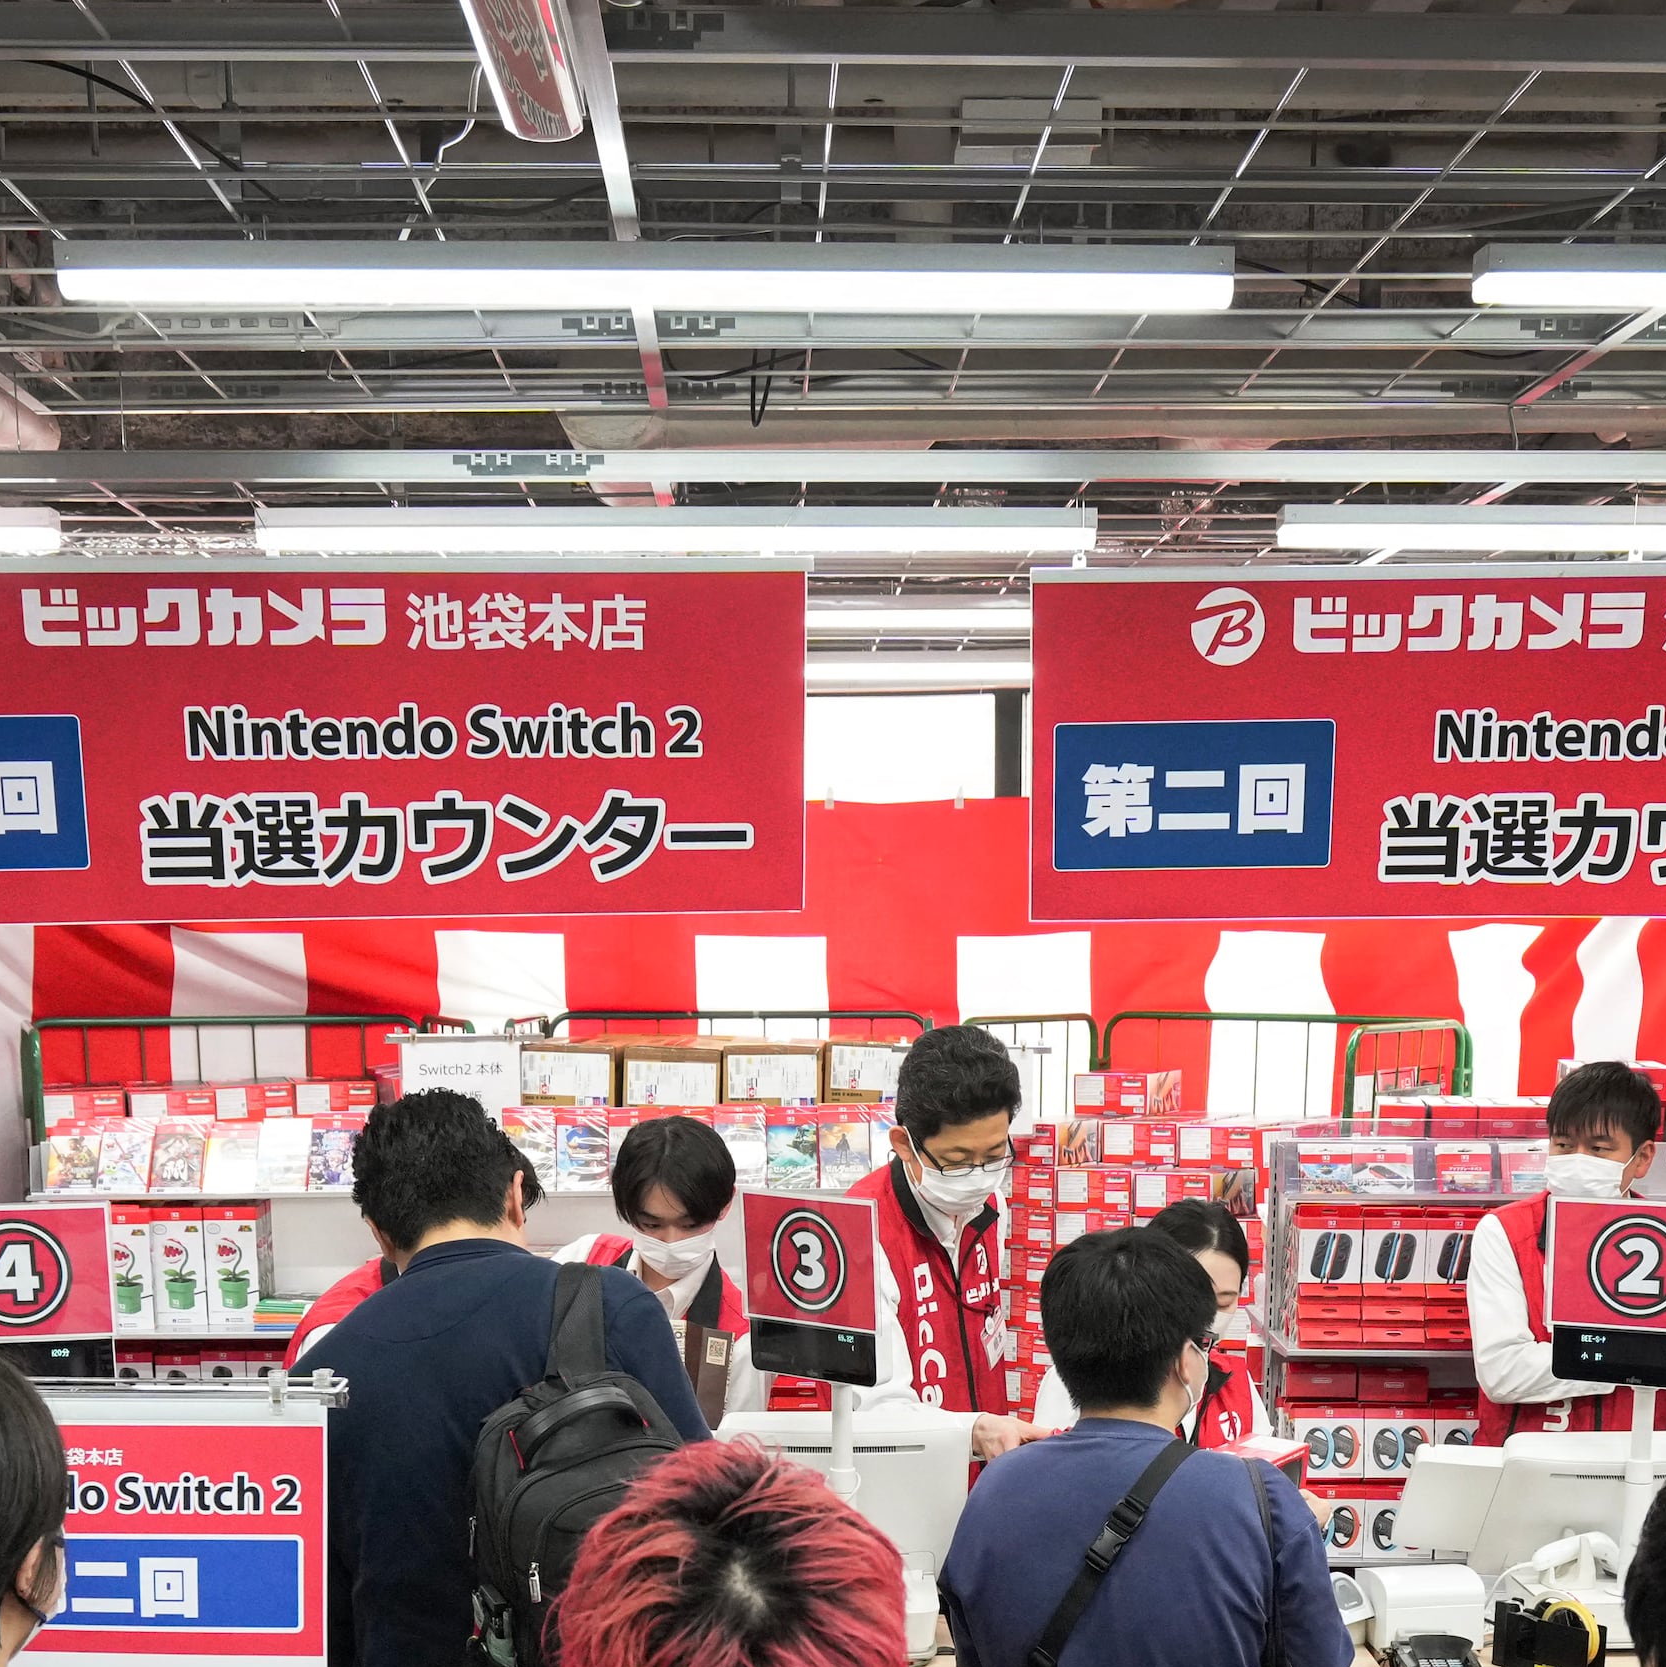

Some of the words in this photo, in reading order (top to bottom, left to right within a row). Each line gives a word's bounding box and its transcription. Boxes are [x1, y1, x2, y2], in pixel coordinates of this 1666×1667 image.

[23, 587, 386, 649] ビックカメラ
[406, 592, 647, 652] 池袋本店
[1292, 593, 1647, 652] ビックカメラ
[188, 704, 456, 759] Nintendo
[468, 703, 654, 758] Switch
[666, 704, 703, 759] 2
[1082, 763, 1308, 838] 第二回
[143, 792, 754, 884] 当選カウンター
[418, 1062, 472, 1077] Switch2
[476, 1061, 504, 1076] 本体
[117, 1475, 261, 1513] Switch
[273, 1476, 301, 1513] 2
